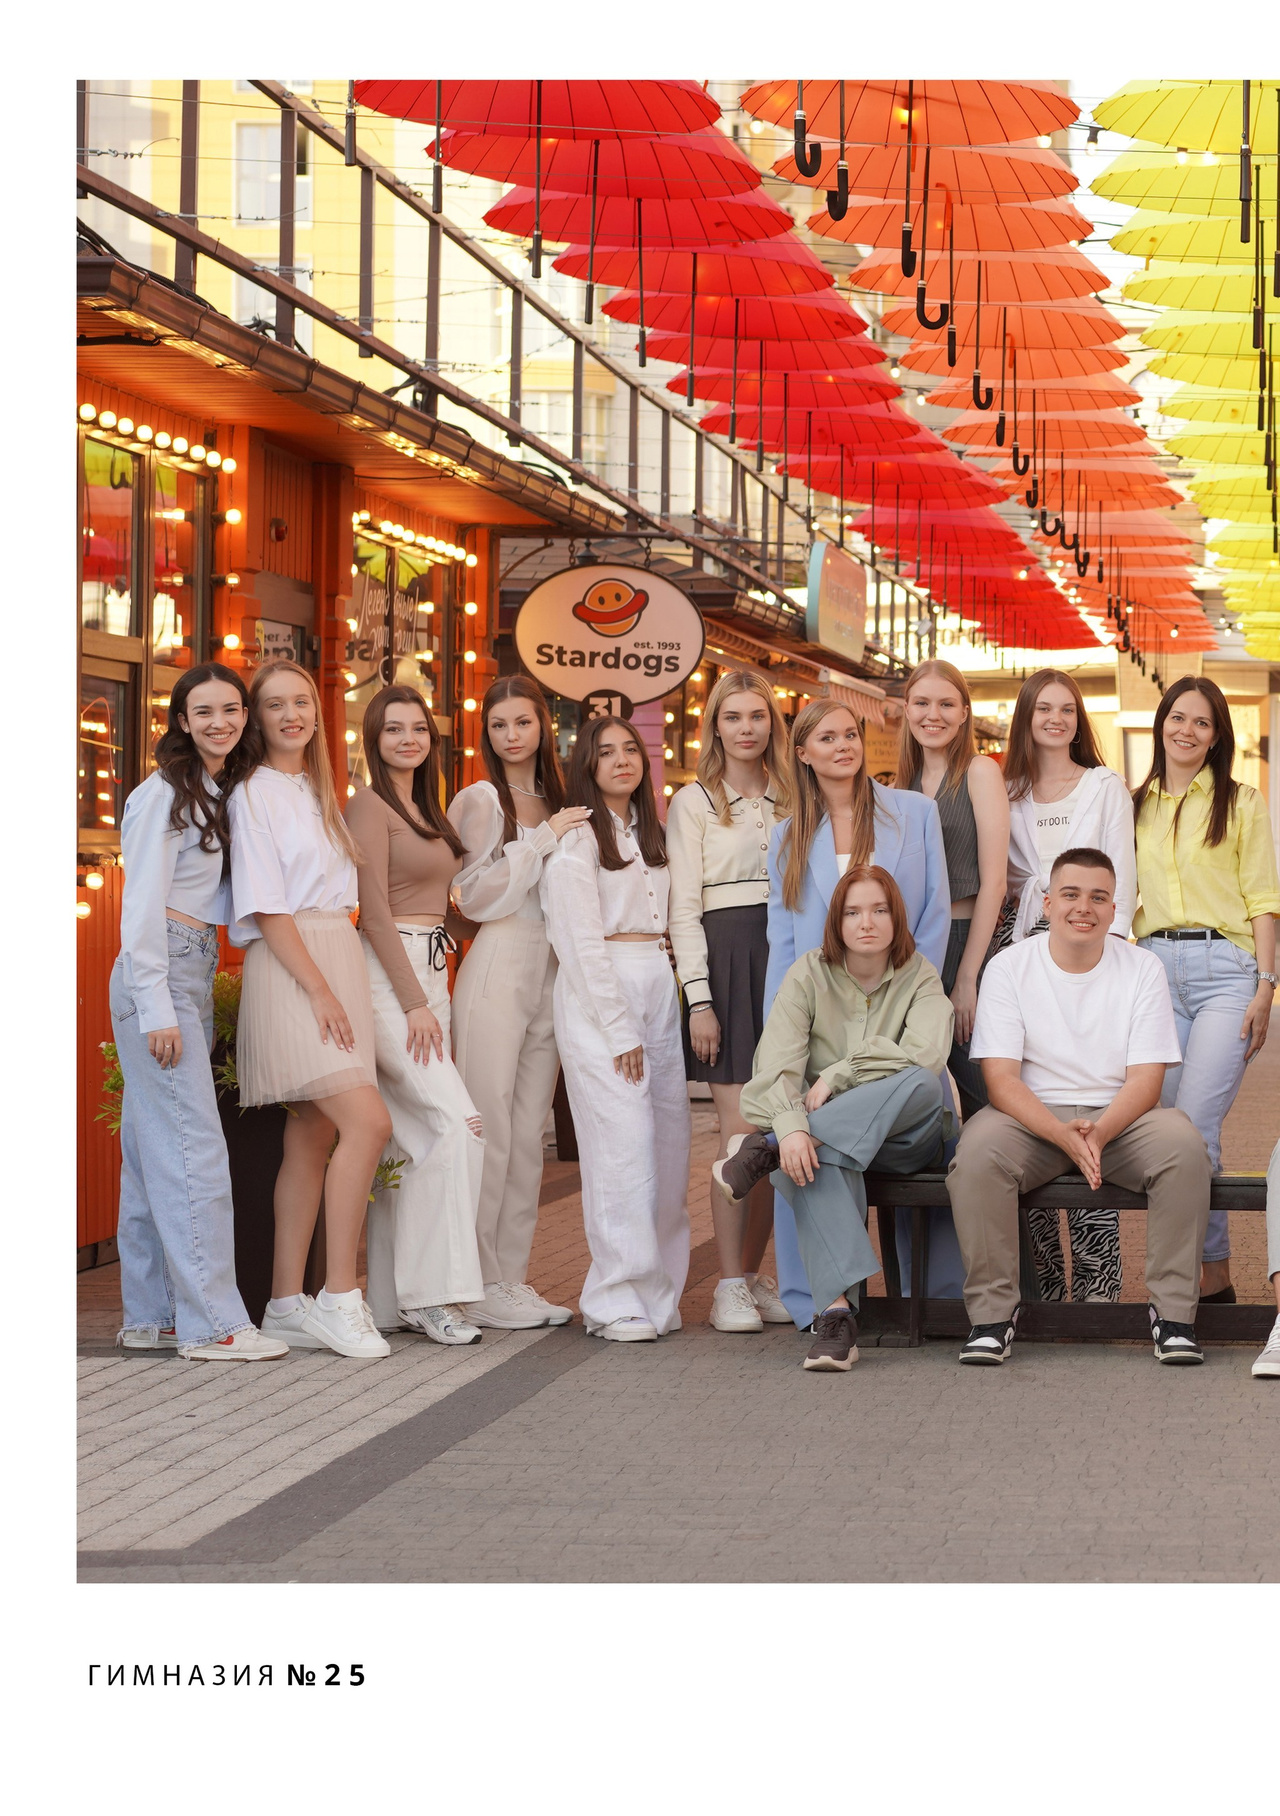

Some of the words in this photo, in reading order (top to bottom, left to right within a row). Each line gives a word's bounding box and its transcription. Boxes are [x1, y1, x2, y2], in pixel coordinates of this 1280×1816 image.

[633, 641, 654, 650] est.
[657, 641, 681, 651] 1993
[536, 643, 680, 677] Stardogs
[588, 696, 622, 720] 31
[1048, 816, 1061, 826] DO
